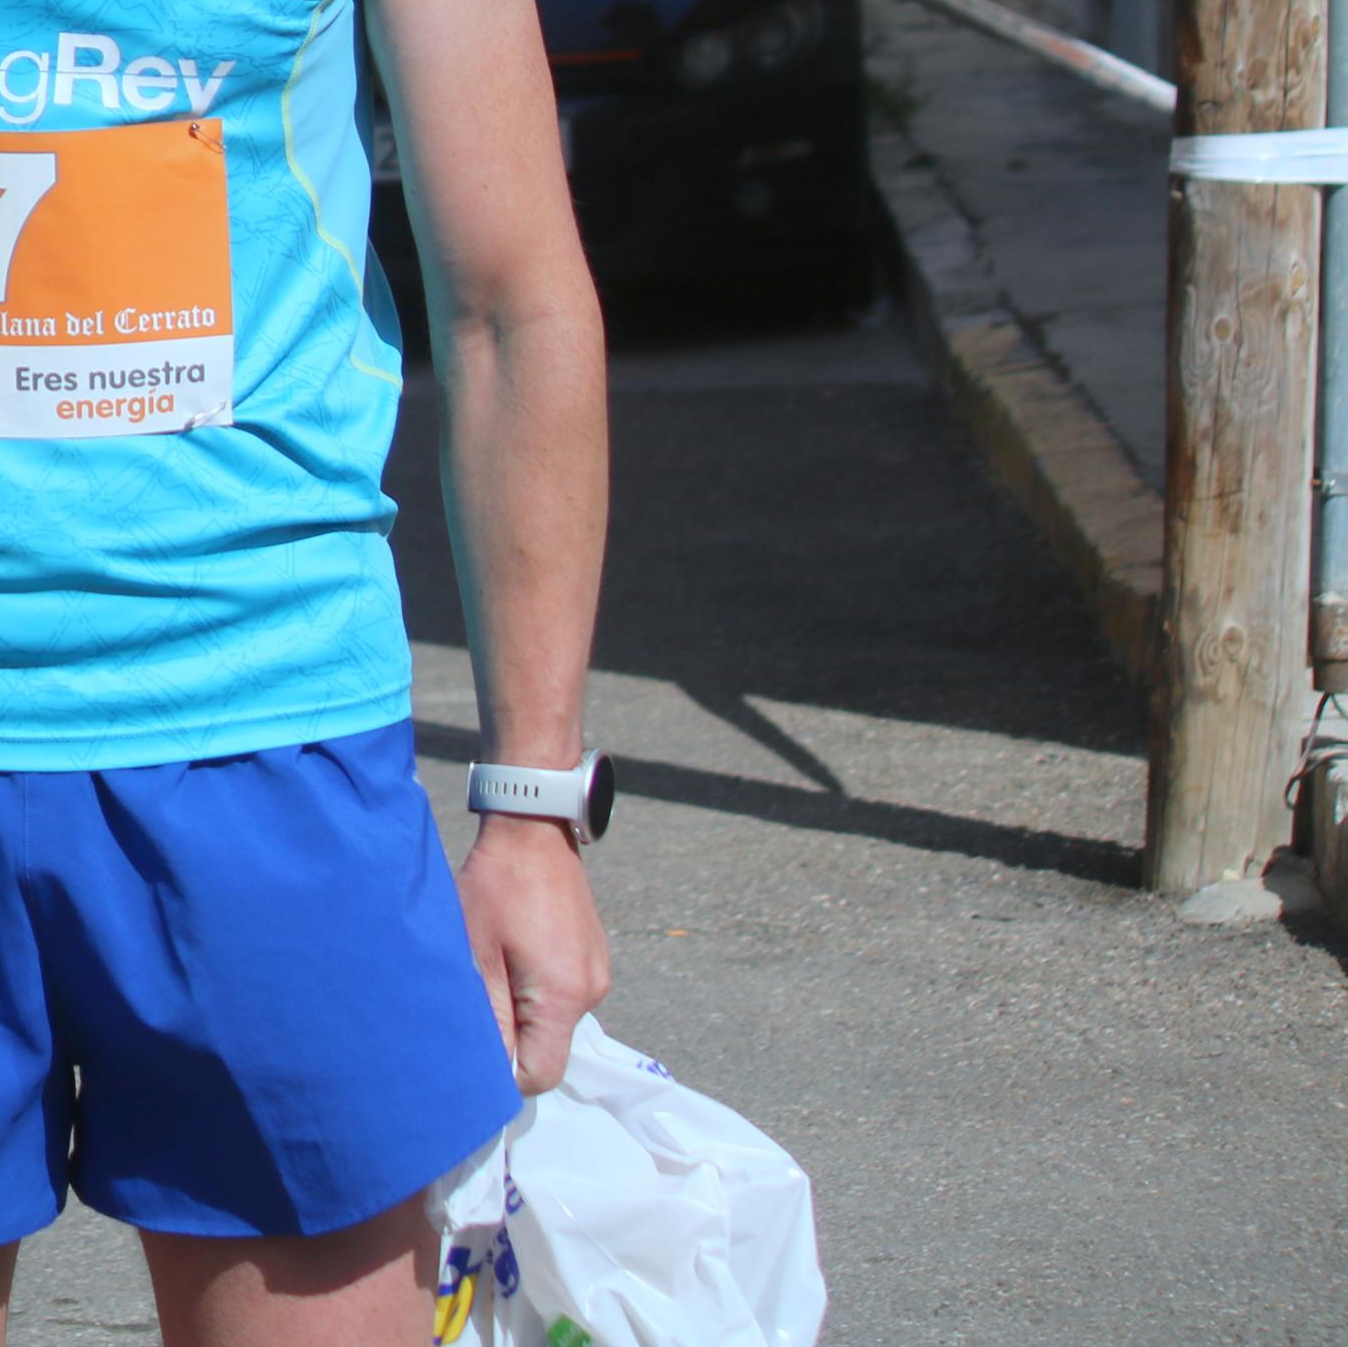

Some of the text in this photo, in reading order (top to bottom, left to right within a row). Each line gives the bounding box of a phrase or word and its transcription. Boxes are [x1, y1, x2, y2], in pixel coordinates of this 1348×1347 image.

[65, 309, 105, 337] del
[114, 305, 216, 335] Cerrato
[15, 361, 206, 394] Eres nuestra
[56, 390, 175, 424] energía
